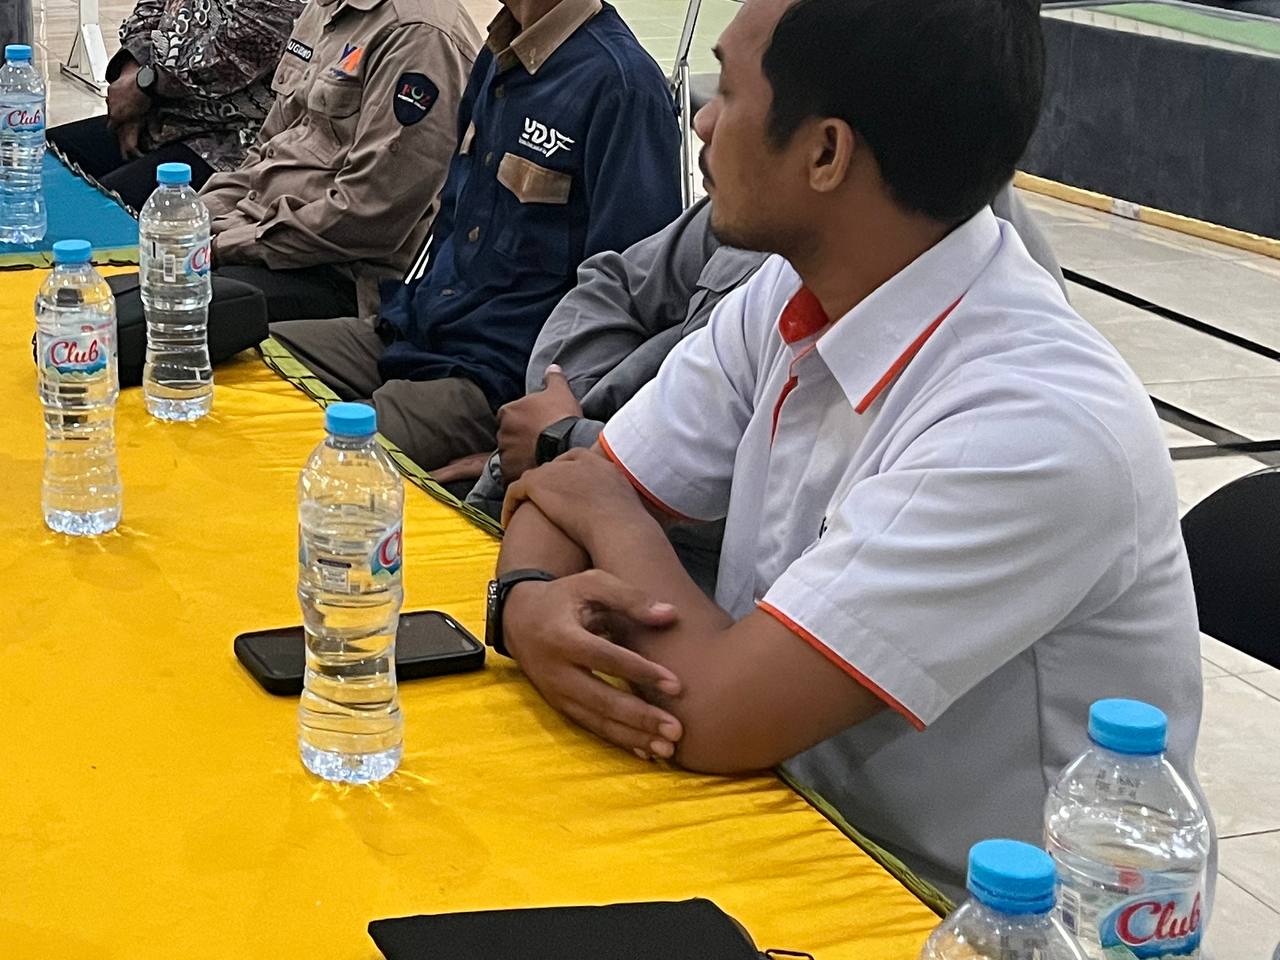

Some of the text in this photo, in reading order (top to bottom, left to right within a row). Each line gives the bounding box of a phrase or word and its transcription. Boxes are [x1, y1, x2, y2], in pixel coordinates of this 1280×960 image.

[7, 109, 41, 127] Club
[50, 339, 99, 365] Club
[1115, 891, 1201, 945] Club
